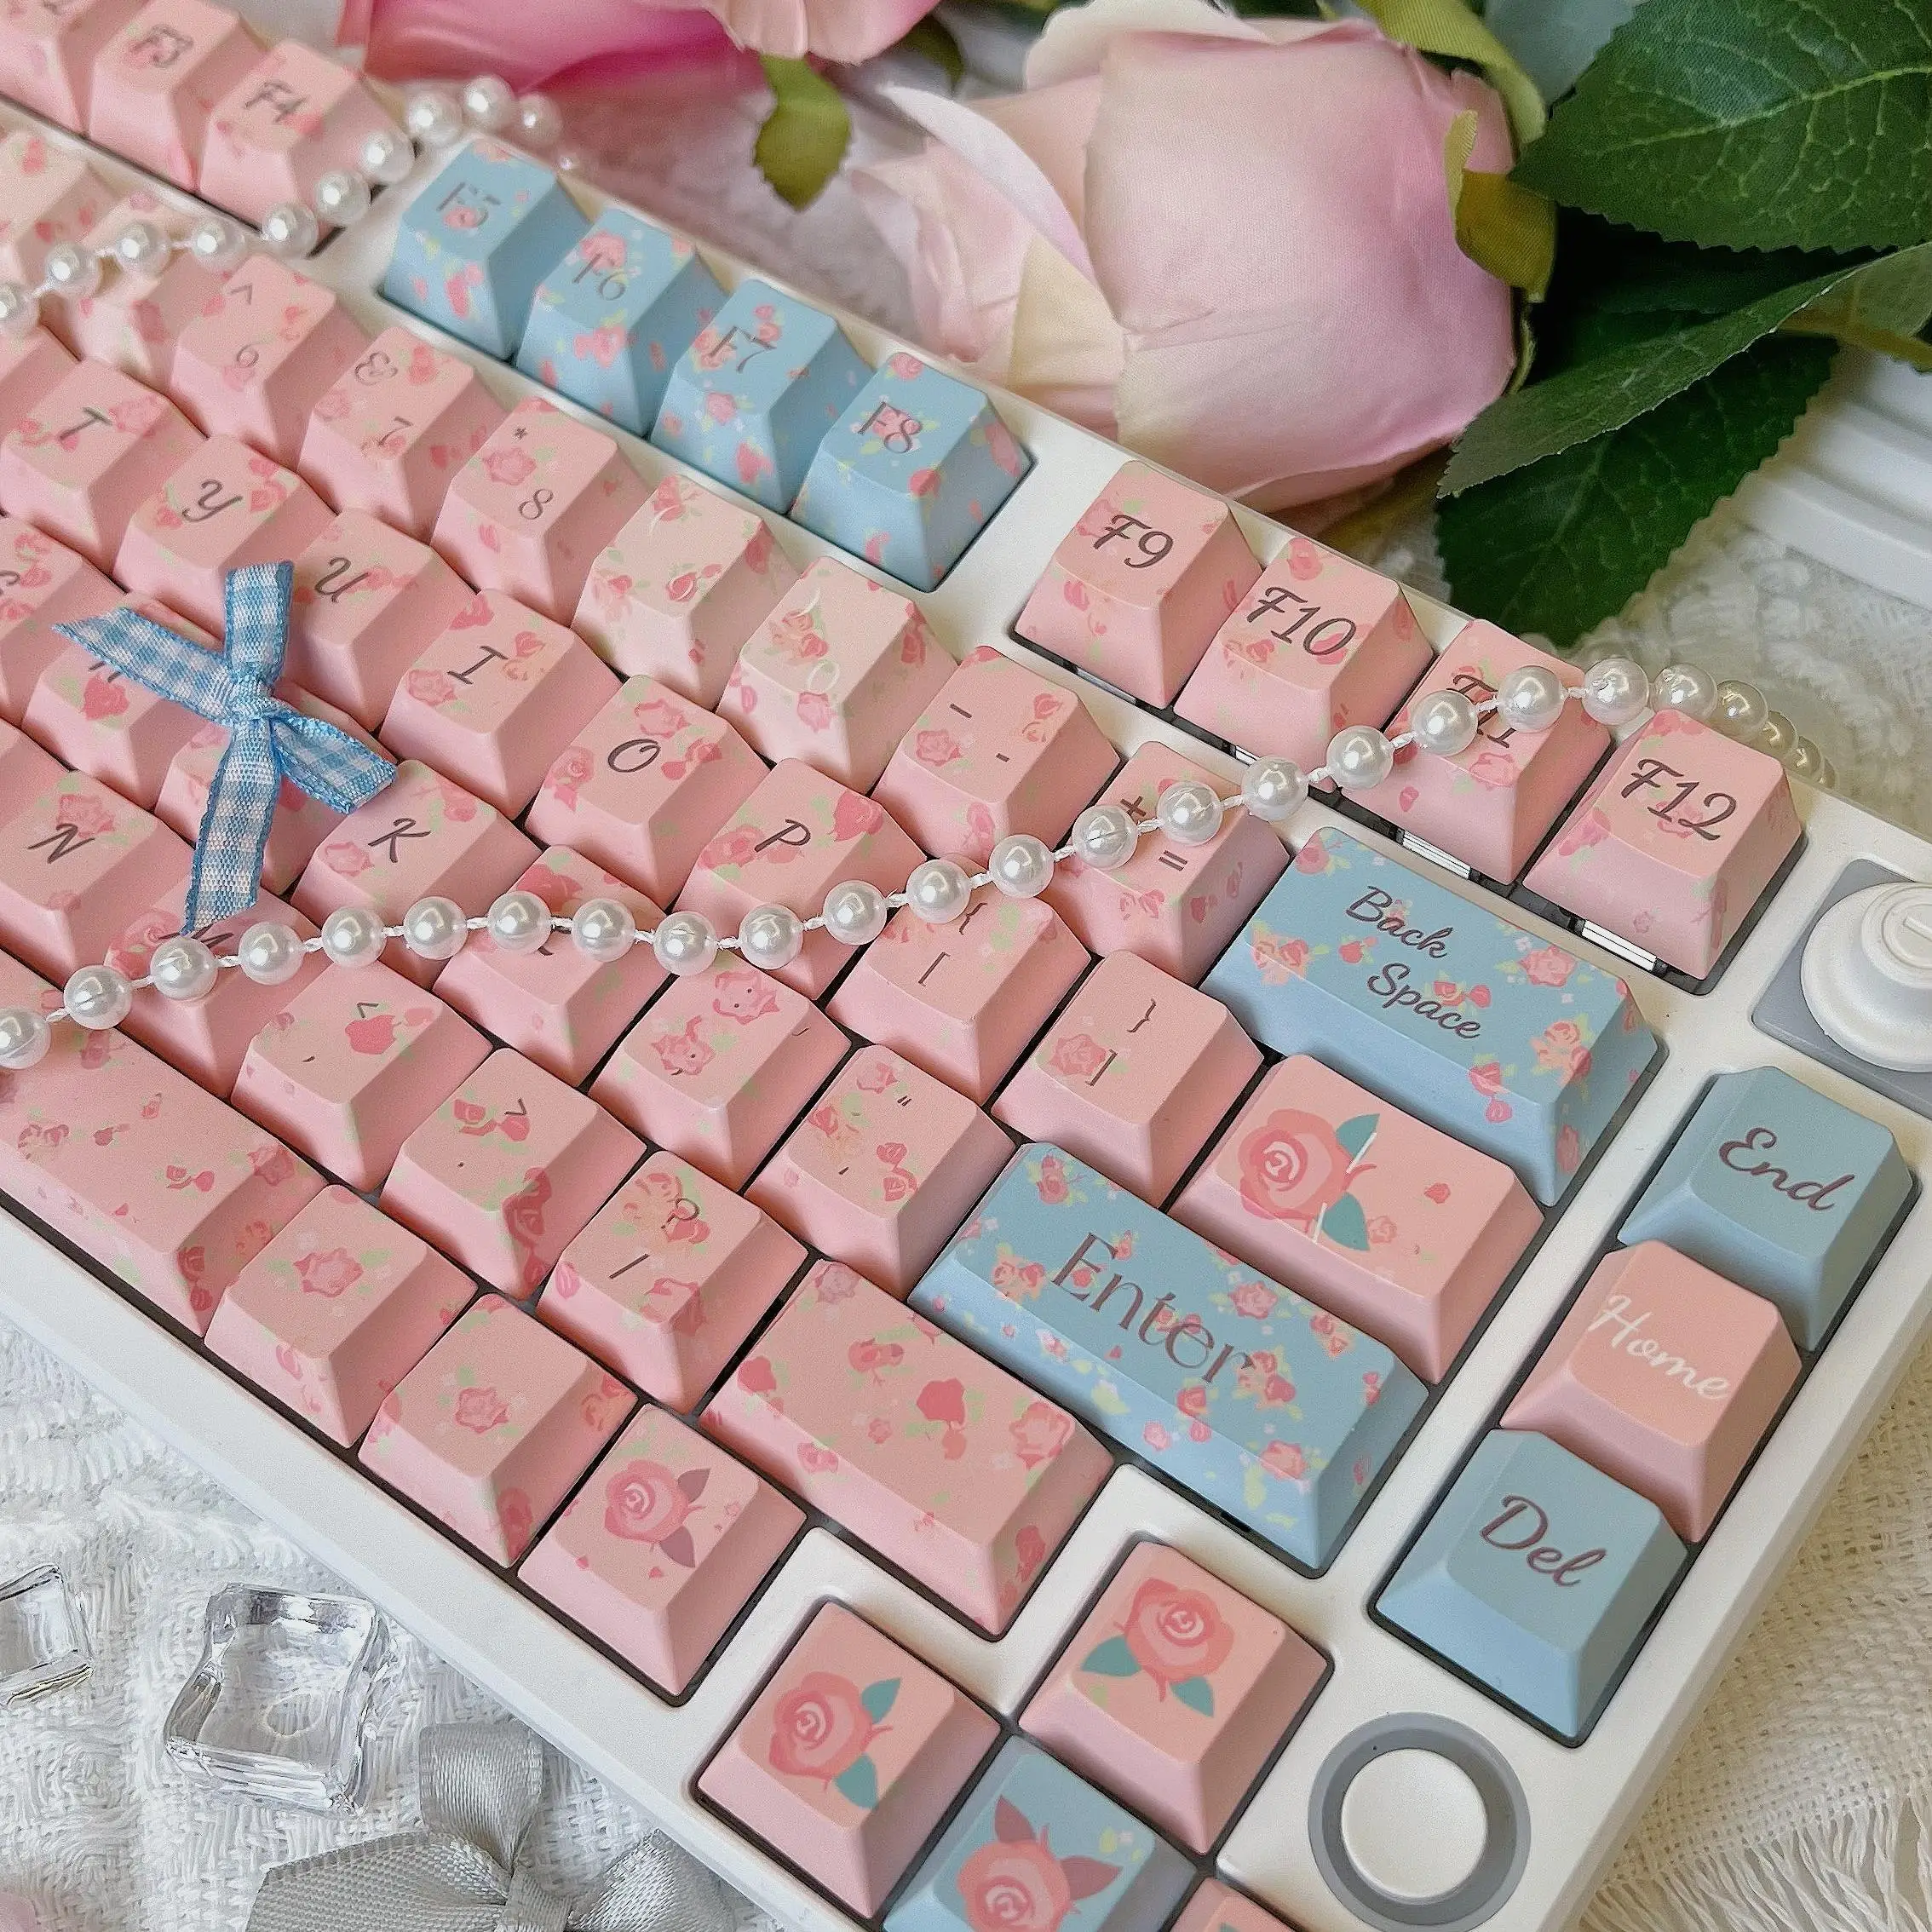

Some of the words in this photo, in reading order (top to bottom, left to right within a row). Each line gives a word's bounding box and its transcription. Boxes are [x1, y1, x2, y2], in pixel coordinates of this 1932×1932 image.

[710, 325, 776, 373] F7
[60, 406, 113, 440] T
[856, 400, 923, 454] F8
[518, 488, 555, 520] 8
[1093, 515, 1174, 569] F9
[314, 556, 369, 603] U
[1245, 585, 1356, 657] F10
[447, 645, 509, 685] I
[607, 738, 661, 773] O
[1621, 759, 1738, 841] F12
[28, 823, 95, 865] N
[368, 818, 432, 863] K
[755, 819, 812, 853] P
[1345, 884, 1455, 959] Back
[1366, 962, 1482, 1040] Space
[1717, 1126, 1855, 1211] End
[1051, 1232, 1256, 1383] Enter
[1587, 1294, 1732, 1400] Home
[1480, 1492, 1607, 1588] Del
